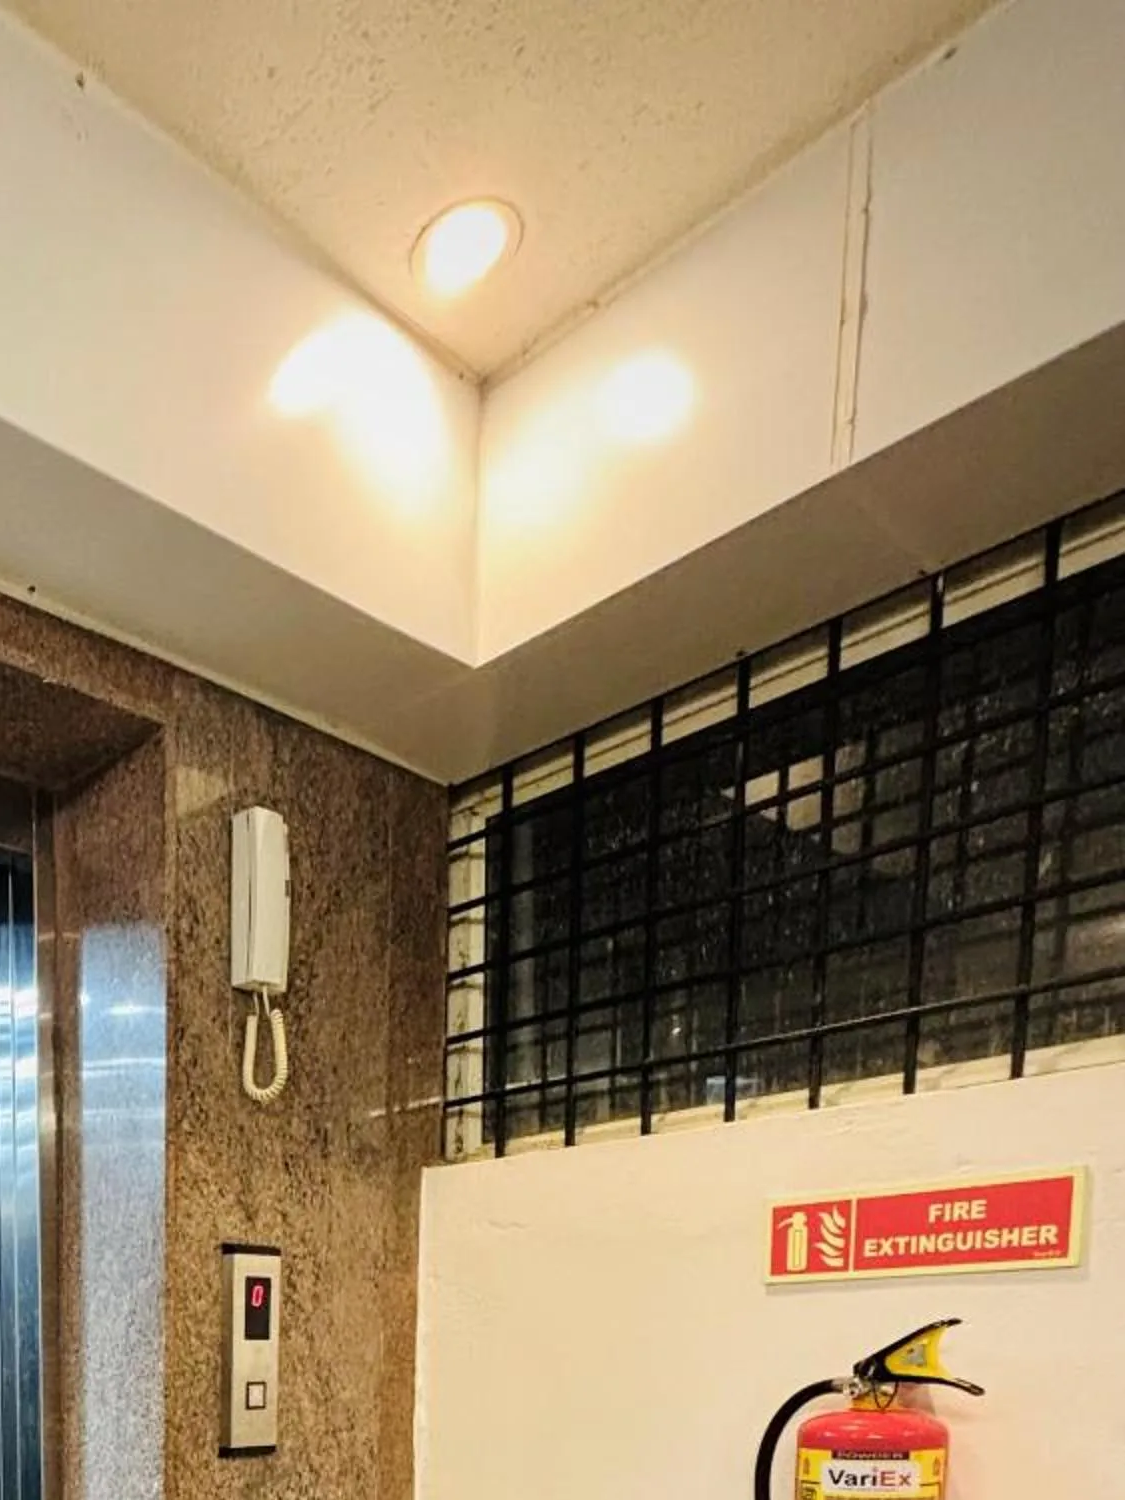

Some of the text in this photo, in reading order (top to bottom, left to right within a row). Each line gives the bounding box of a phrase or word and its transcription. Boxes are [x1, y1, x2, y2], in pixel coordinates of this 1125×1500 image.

[928, 1199, 987, 1224] FIRE
[863, 1224, 1059, 1258] EXTINGUISHER
[828, 1466, 912, 1487] VariEx
